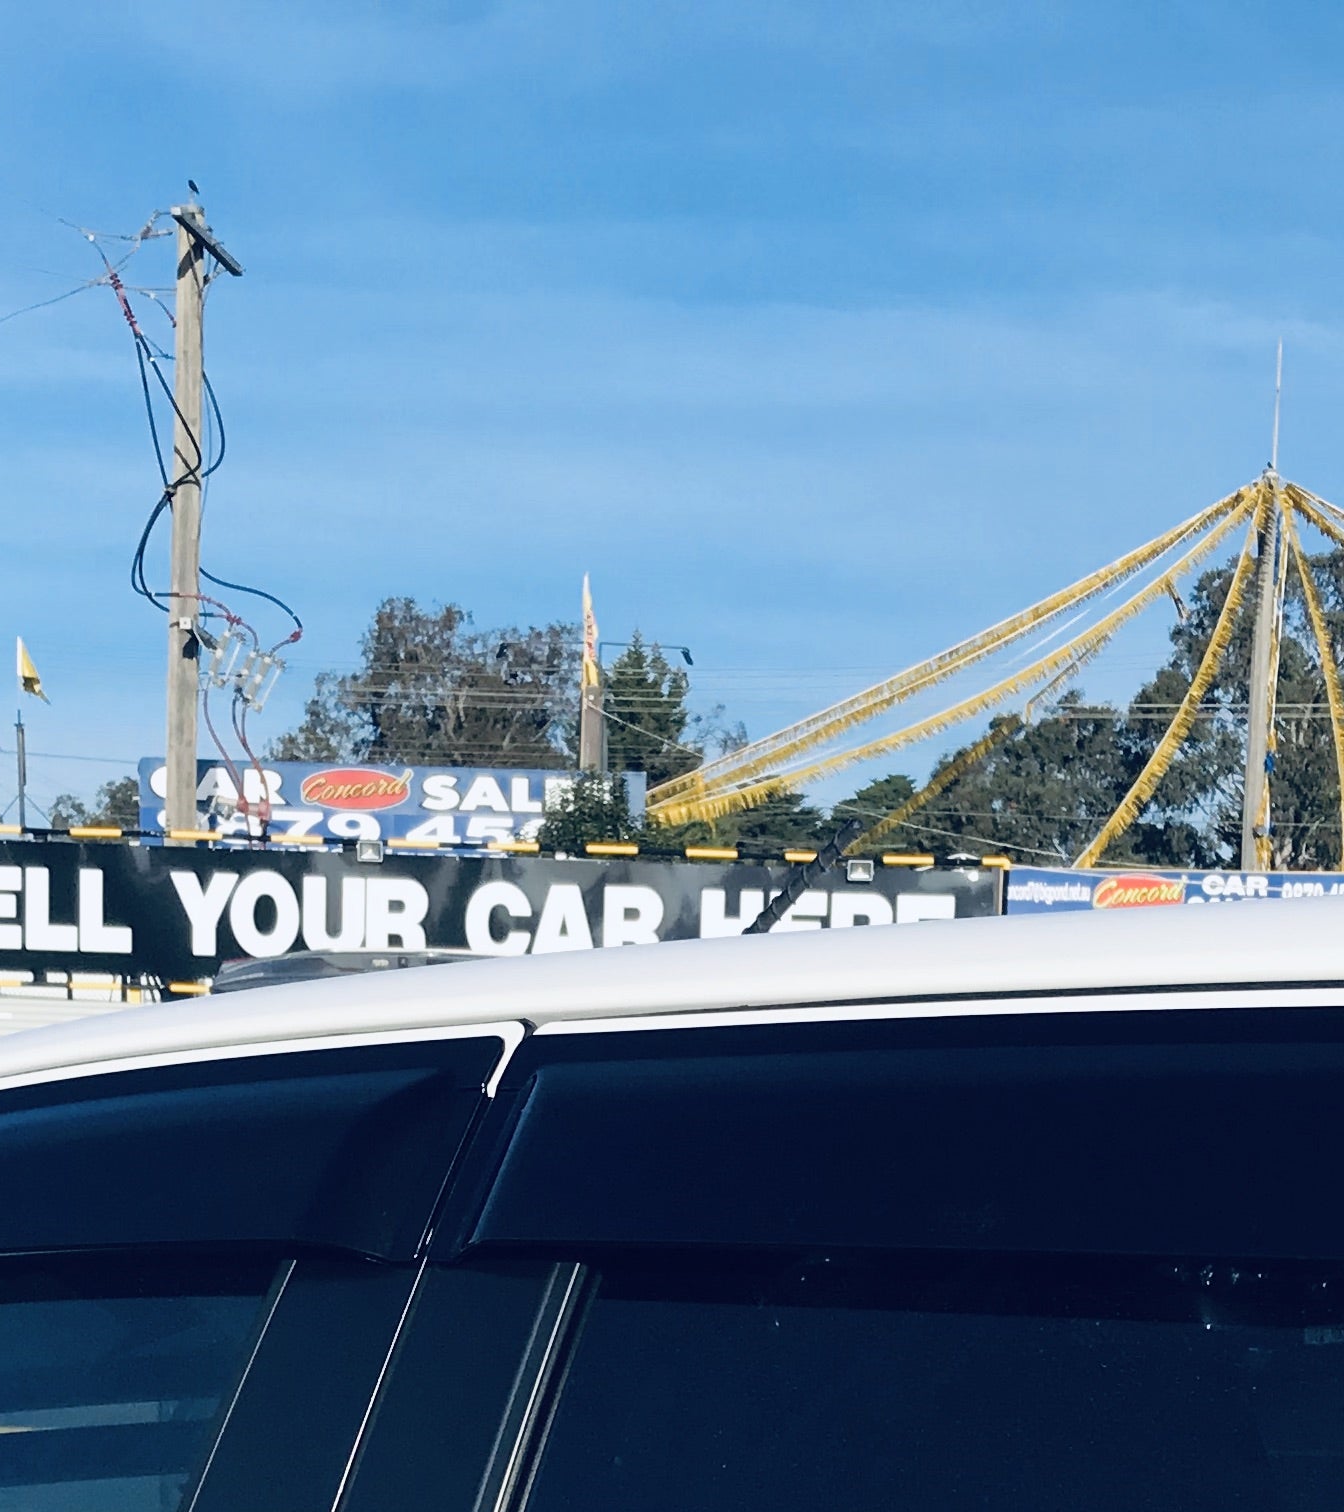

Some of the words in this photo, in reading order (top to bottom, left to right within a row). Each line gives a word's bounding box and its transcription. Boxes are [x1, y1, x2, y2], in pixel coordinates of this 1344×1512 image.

[303, 768, 413, 804] Concord
[1093, 875, 1188, 909] Concord
[1202, 874, 1269, 896] CAR
[170, 871, 429, 957] YOUR
[465, 881, 665, 956] CAR
